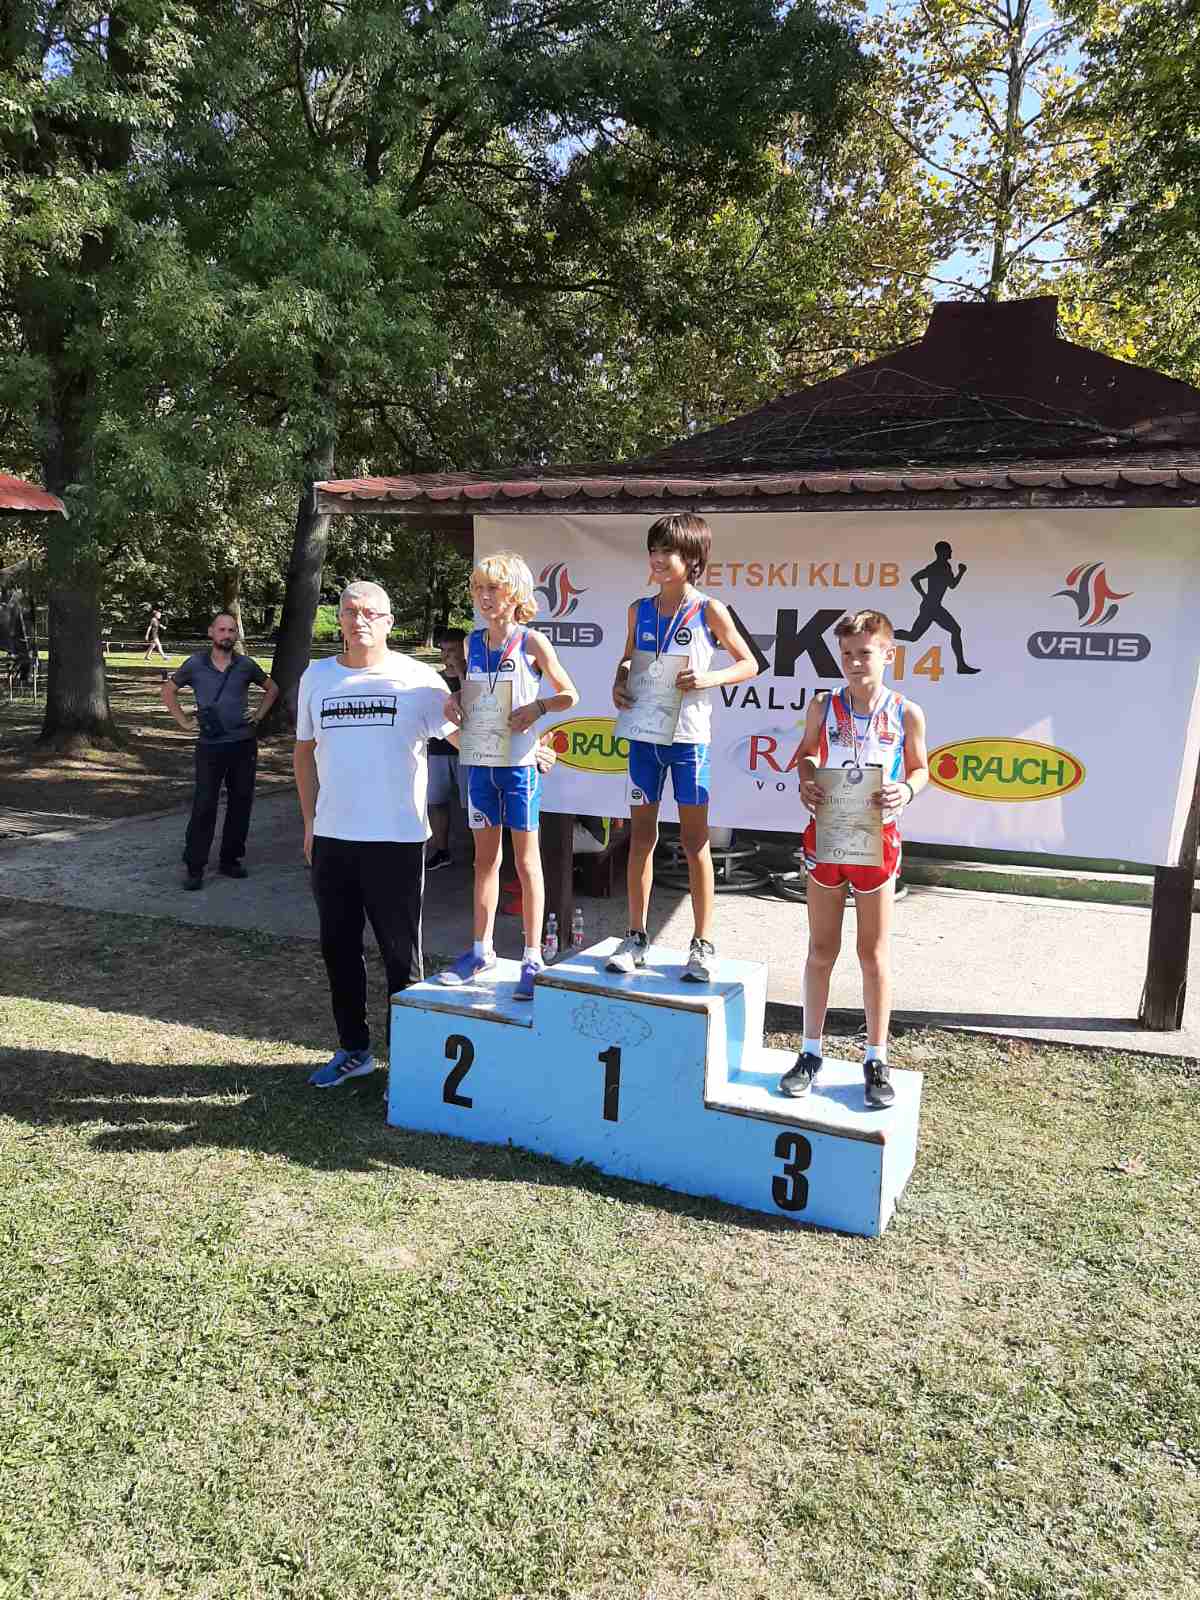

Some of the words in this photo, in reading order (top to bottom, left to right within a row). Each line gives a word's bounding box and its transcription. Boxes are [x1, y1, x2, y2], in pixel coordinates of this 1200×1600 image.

[647, 562, 799, 588] ETSKI
[808, 562, 900, 588] KLUB
[1036, 636, 1139, 658] VALIS
[720, 685, 832, 711] VALJ
[572, 732, 630, 759] RAUC
[961, 753, 1066, 786] RAUCH
[443, 1034, 474, 1109] 2
[598, 1045, 622, 1122] 1
[771, 1131, 812, 1212] 3
